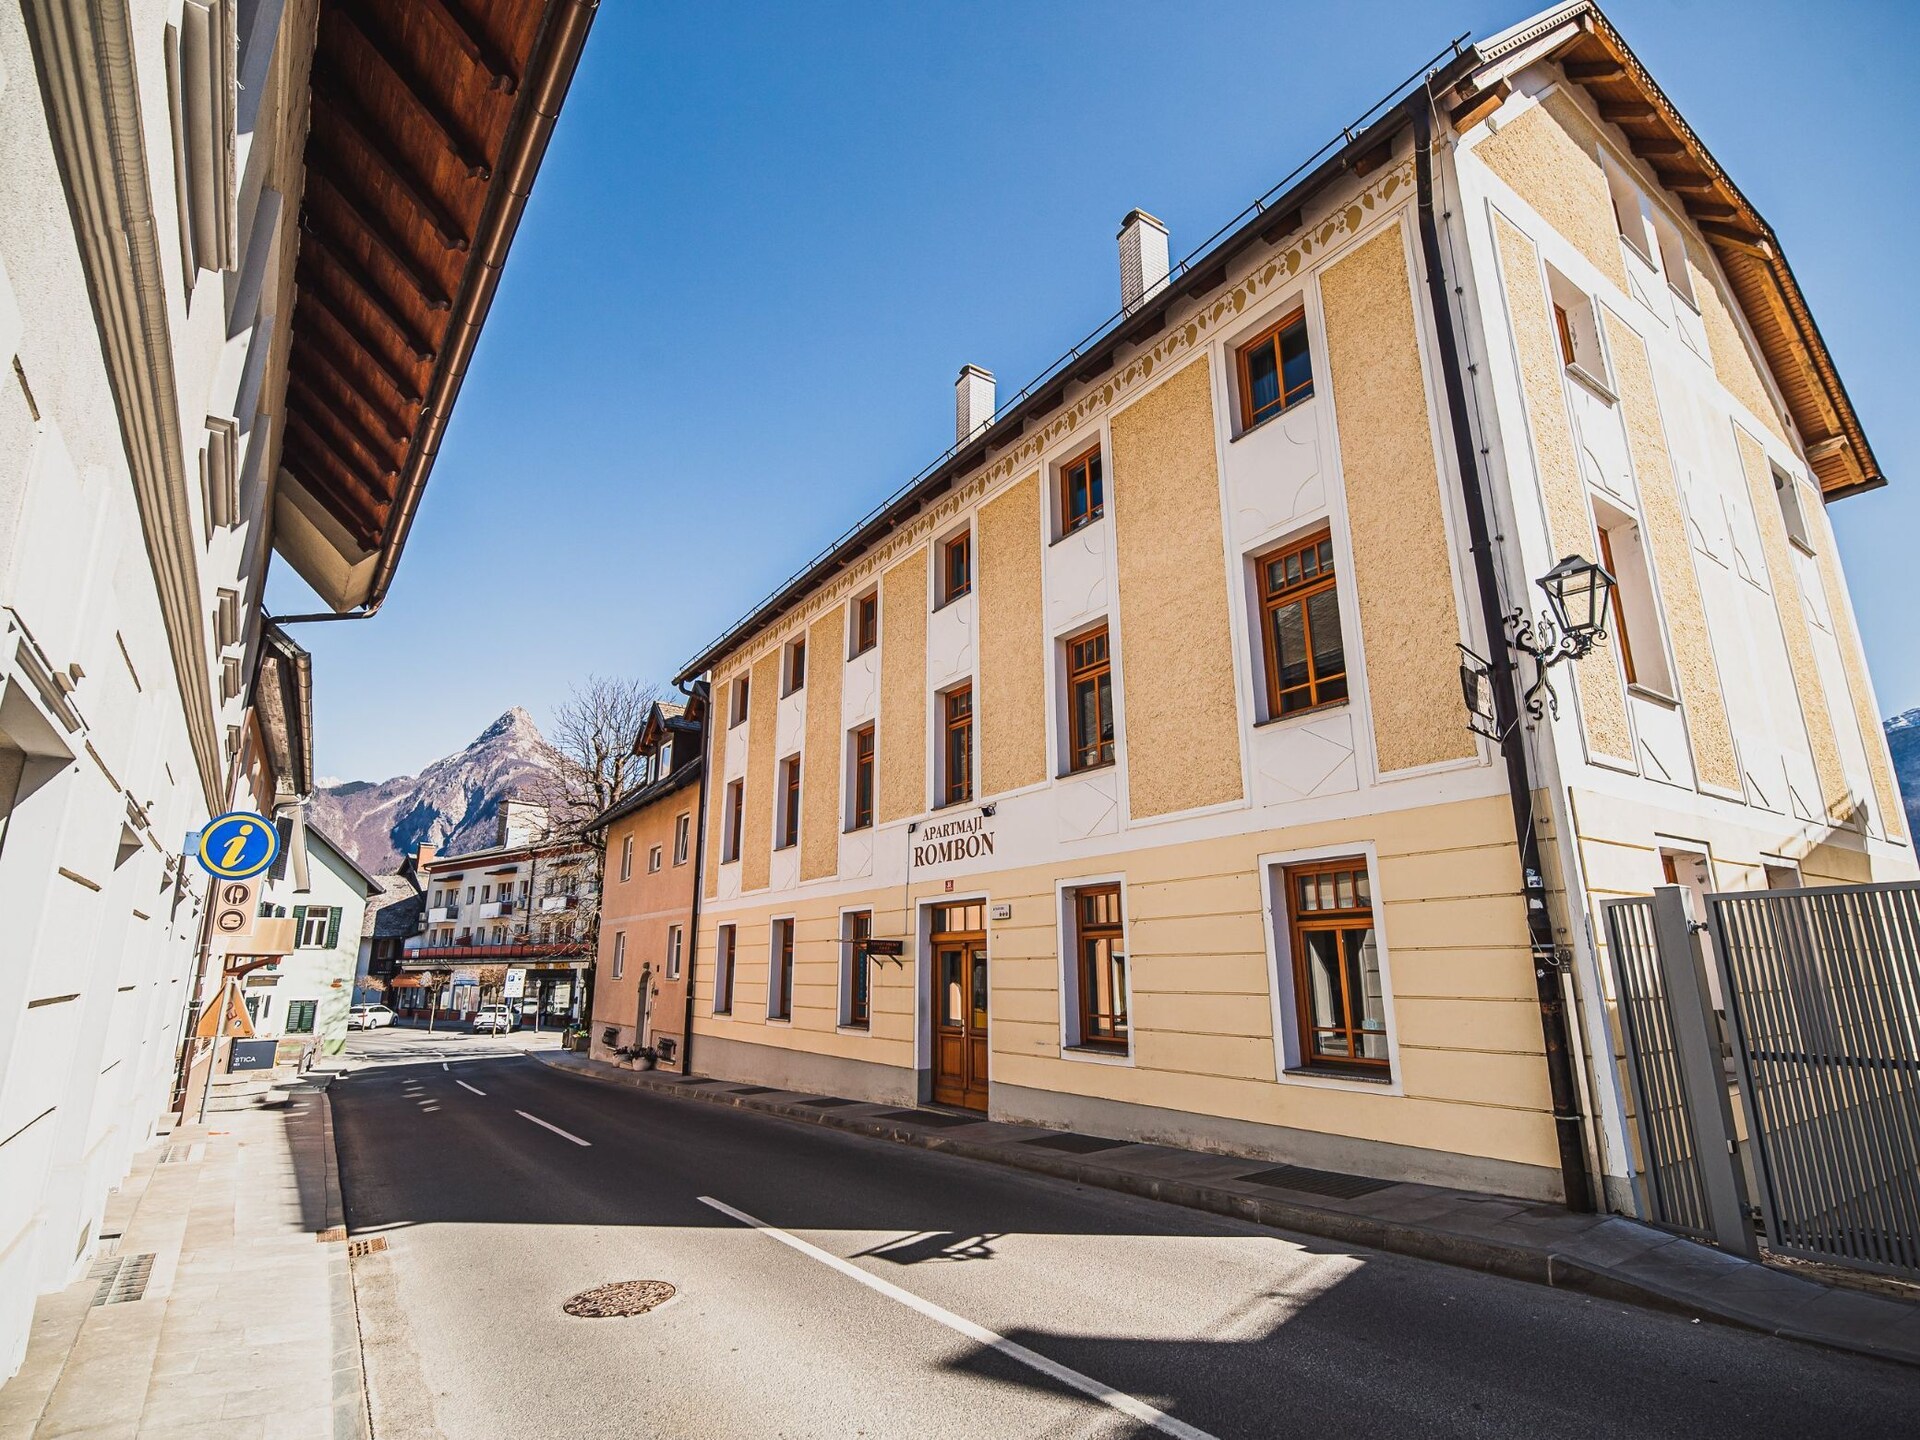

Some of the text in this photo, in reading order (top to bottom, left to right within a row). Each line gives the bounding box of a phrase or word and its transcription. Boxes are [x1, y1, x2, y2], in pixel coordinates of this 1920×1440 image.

[221, 824, 253, 868] i
[923, 816, 983, 841] APARTMAJI
[914, 832, 995, 867] ROMBON
